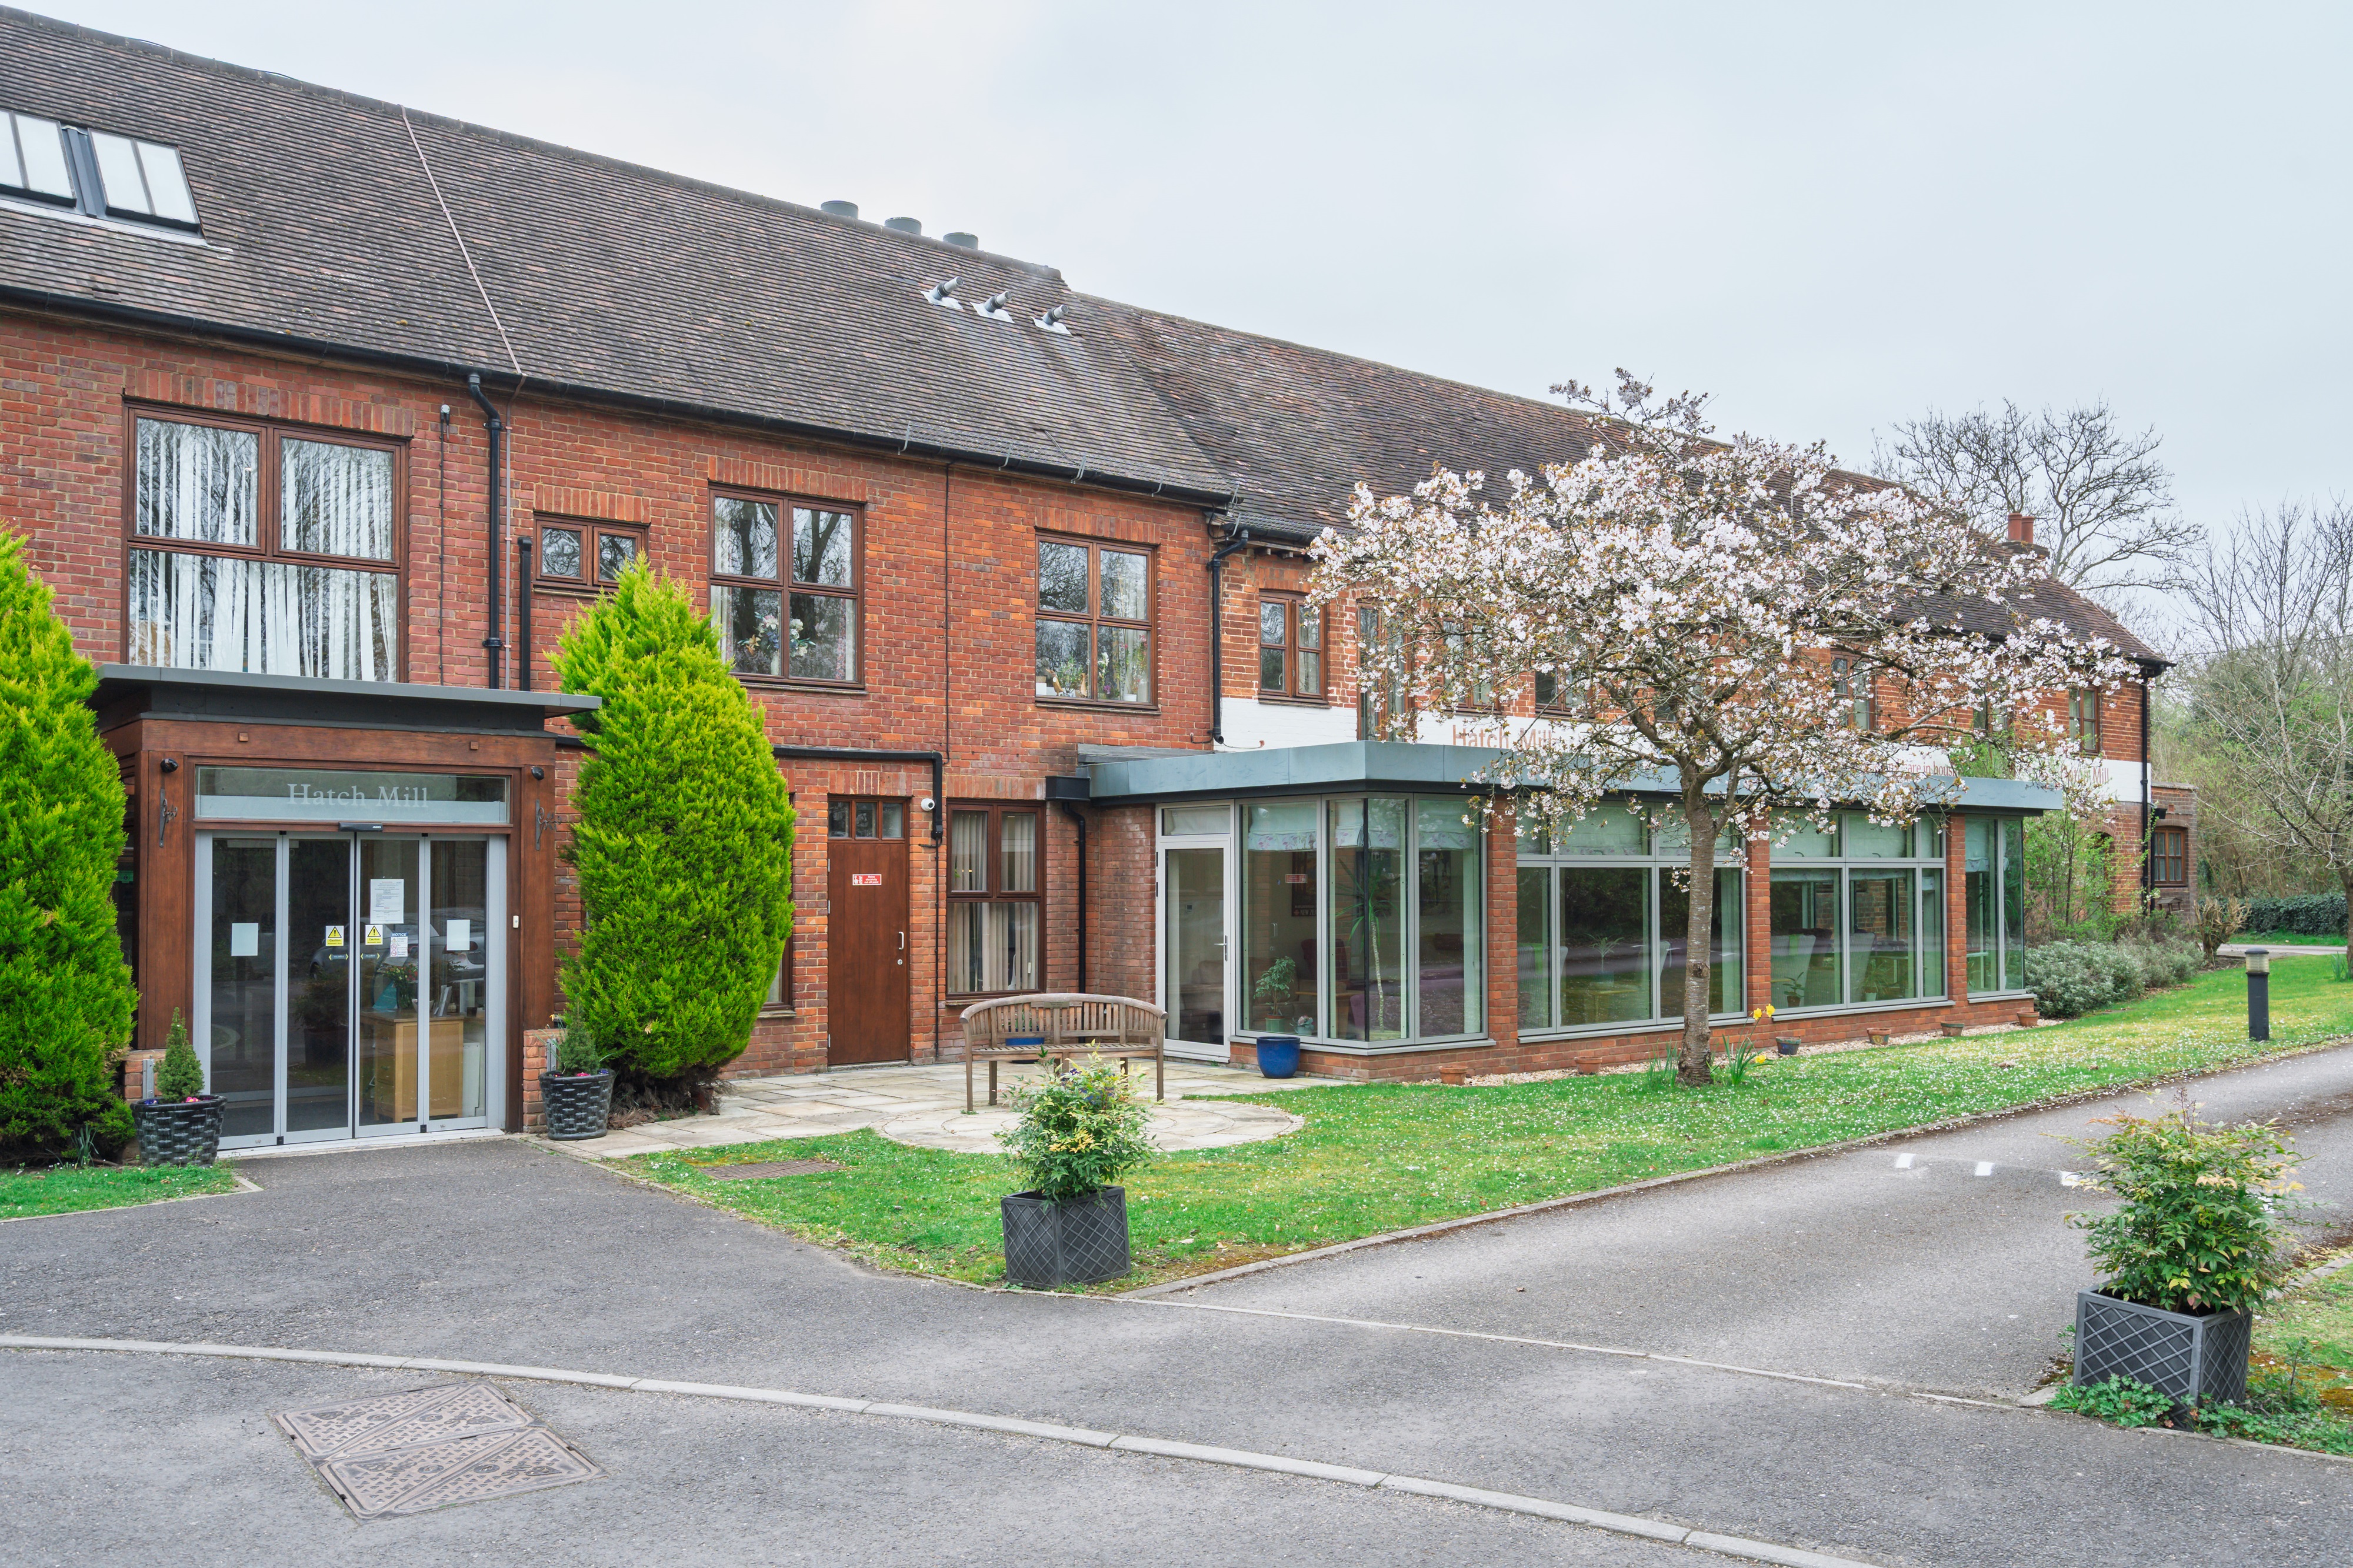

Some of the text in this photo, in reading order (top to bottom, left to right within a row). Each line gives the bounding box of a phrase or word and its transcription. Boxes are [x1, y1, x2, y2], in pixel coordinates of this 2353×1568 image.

[1452, 725, 1551, 751] Hatch Mill
[2093, 766, 2109, 785] Mill
[287, 783, 428, 808] Hatch Mill
